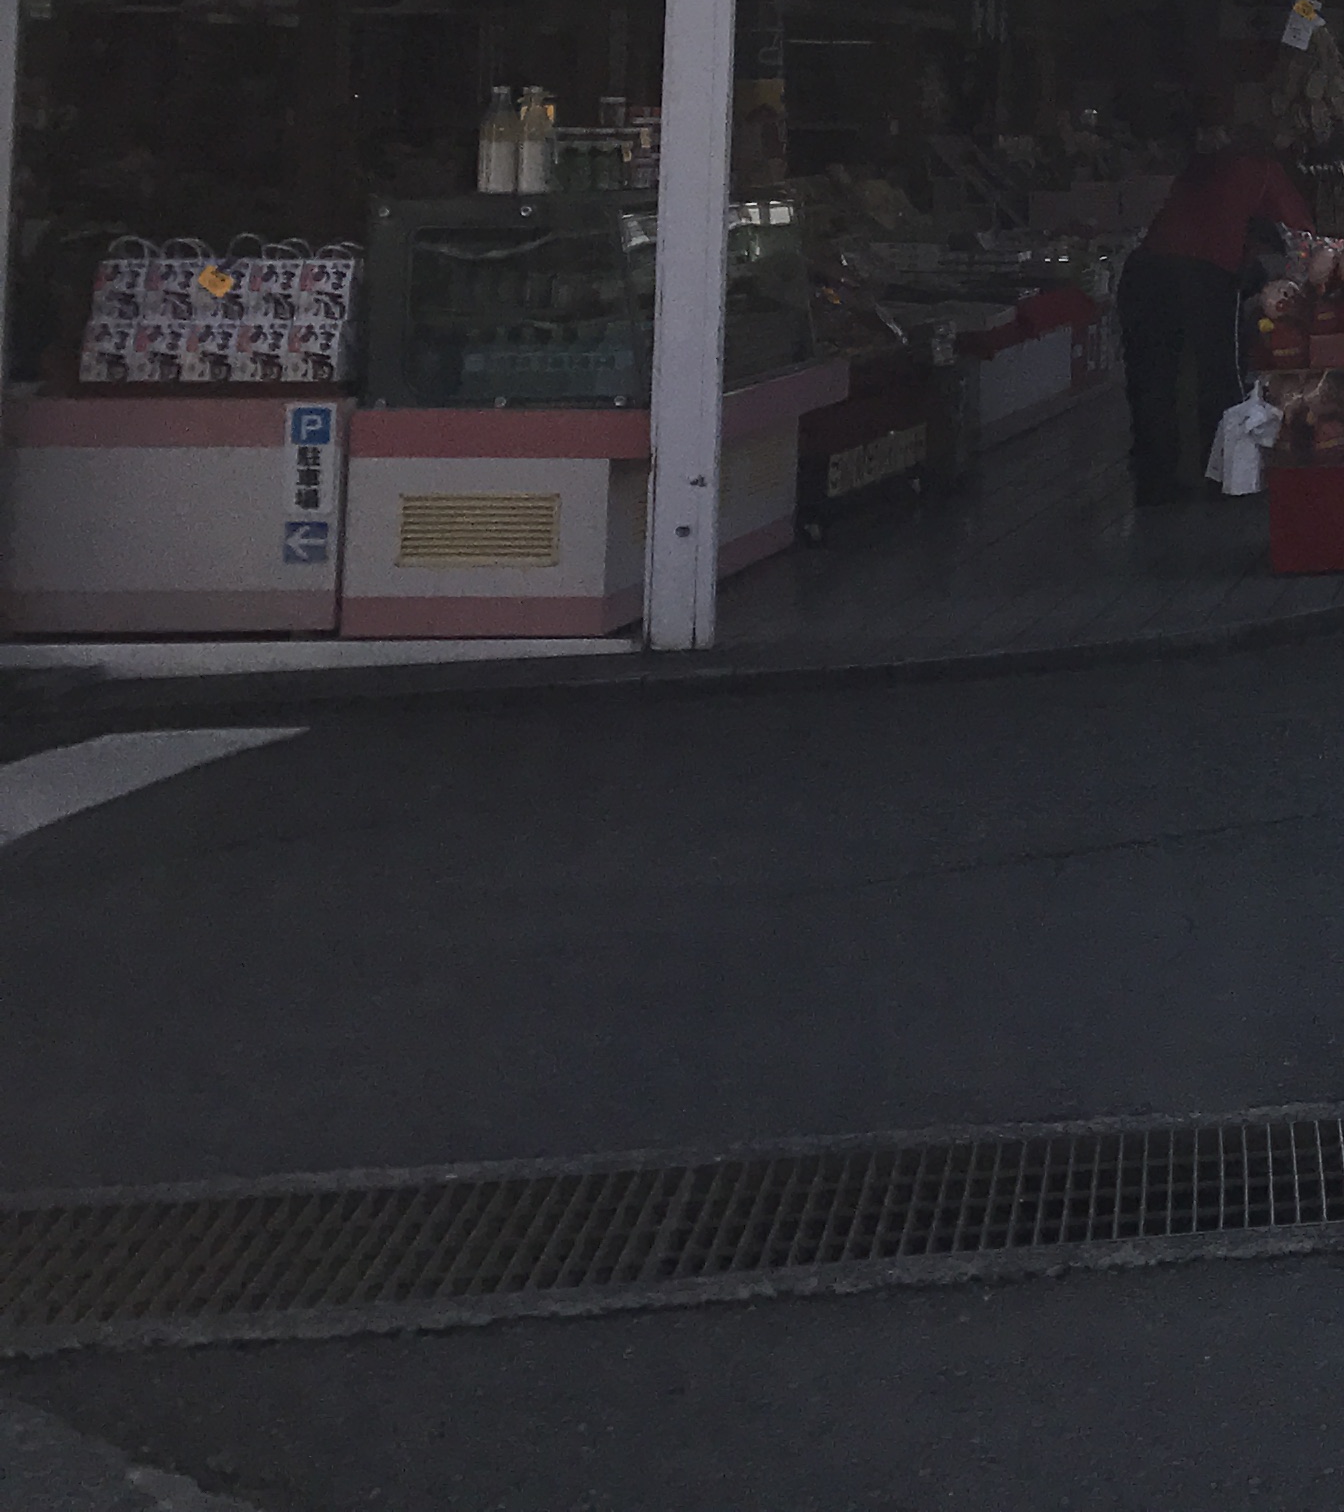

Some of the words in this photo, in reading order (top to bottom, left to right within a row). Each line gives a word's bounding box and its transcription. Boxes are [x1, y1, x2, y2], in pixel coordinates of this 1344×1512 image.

[300, 414, 323, 441] P
[294, 446, 321, 510] 駐車場
